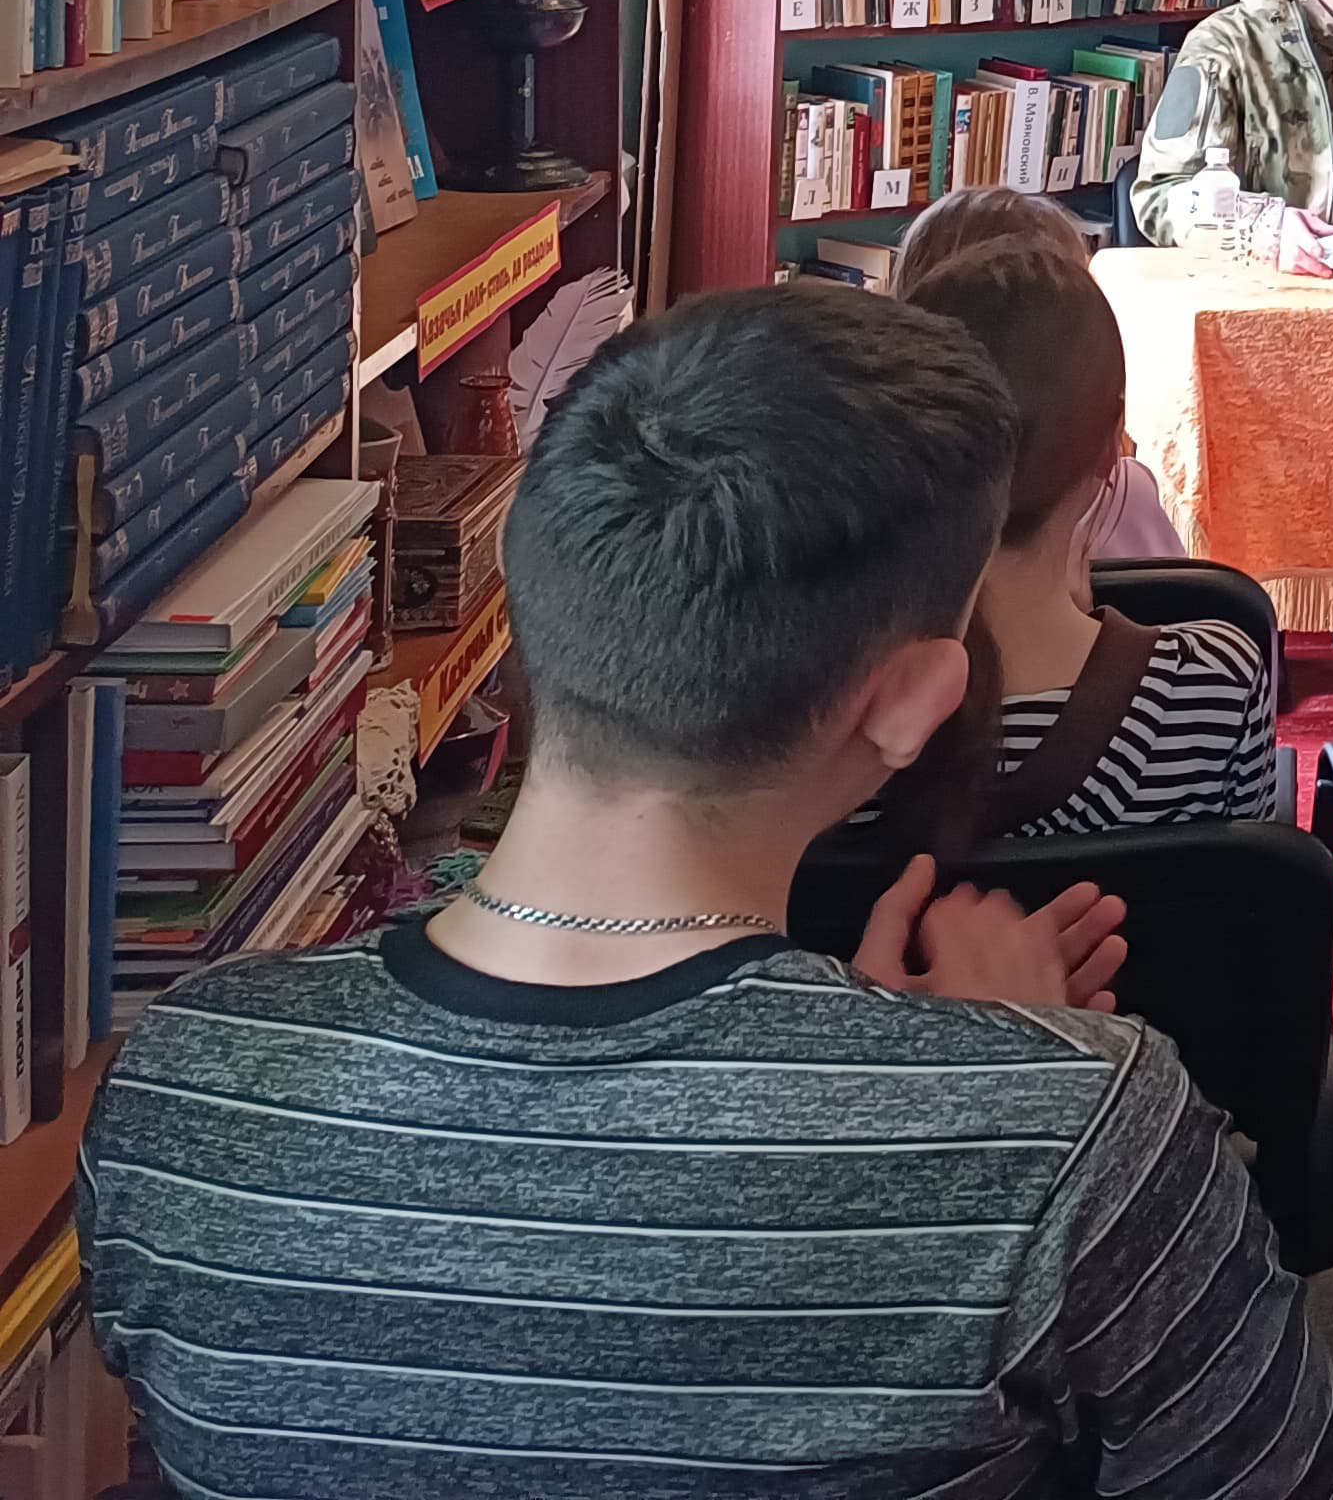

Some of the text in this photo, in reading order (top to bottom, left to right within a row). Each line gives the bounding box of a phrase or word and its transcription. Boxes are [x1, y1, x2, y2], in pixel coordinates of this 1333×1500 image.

[903, 0, 922, 16] Ж
[1018, 87, 1039, 185] В. Маяковский
[884, 180, 902, 197] М
[15, 783, 27, 923] ТЕЧЕСТВА
